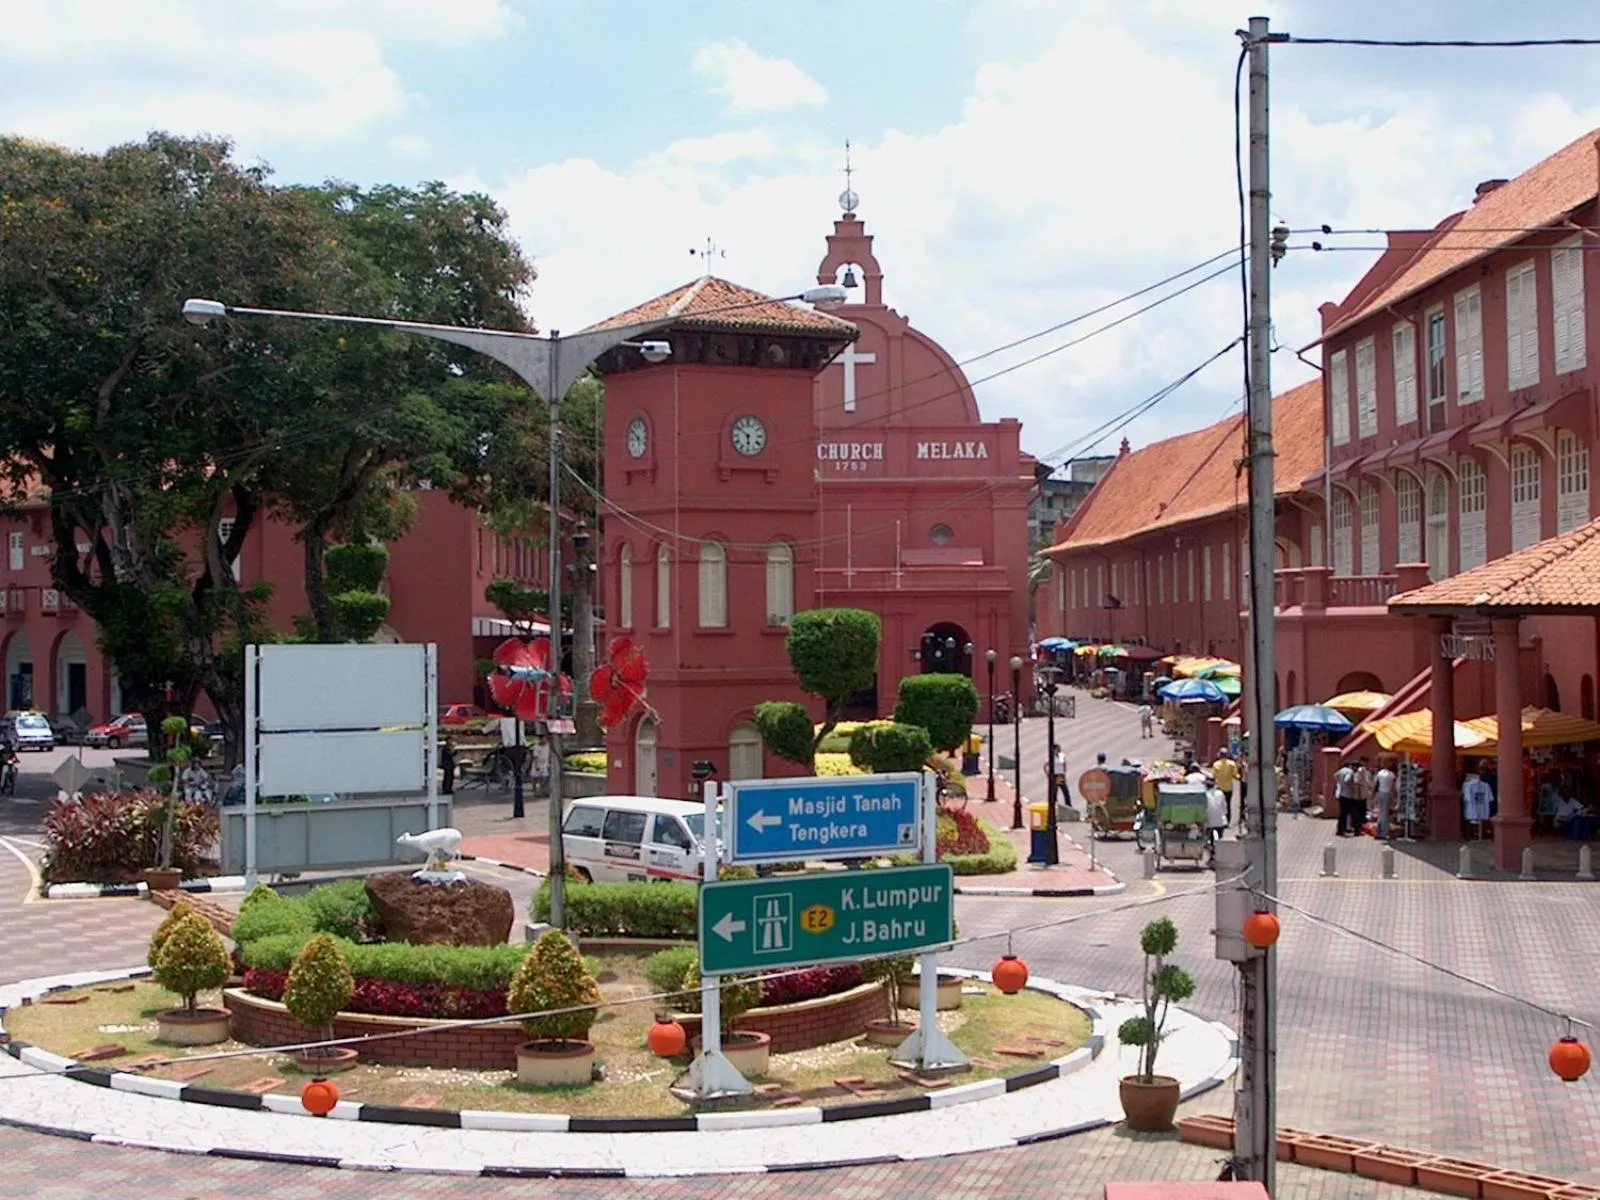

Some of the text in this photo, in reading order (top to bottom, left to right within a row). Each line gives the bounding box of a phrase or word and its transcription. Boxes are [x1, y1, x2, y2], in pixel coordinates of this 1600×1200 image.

[817, 442, 989, 460] CHURCH MELAKA
[788, 793, 902, 819] Masjid Tanah
[788, 822, 868, 844] Tengkera
[841, 885, 943, 911] K.Lumpur
[807, 910, 829, 928] E2
[842, 919, 926, 944] J.Bahru
